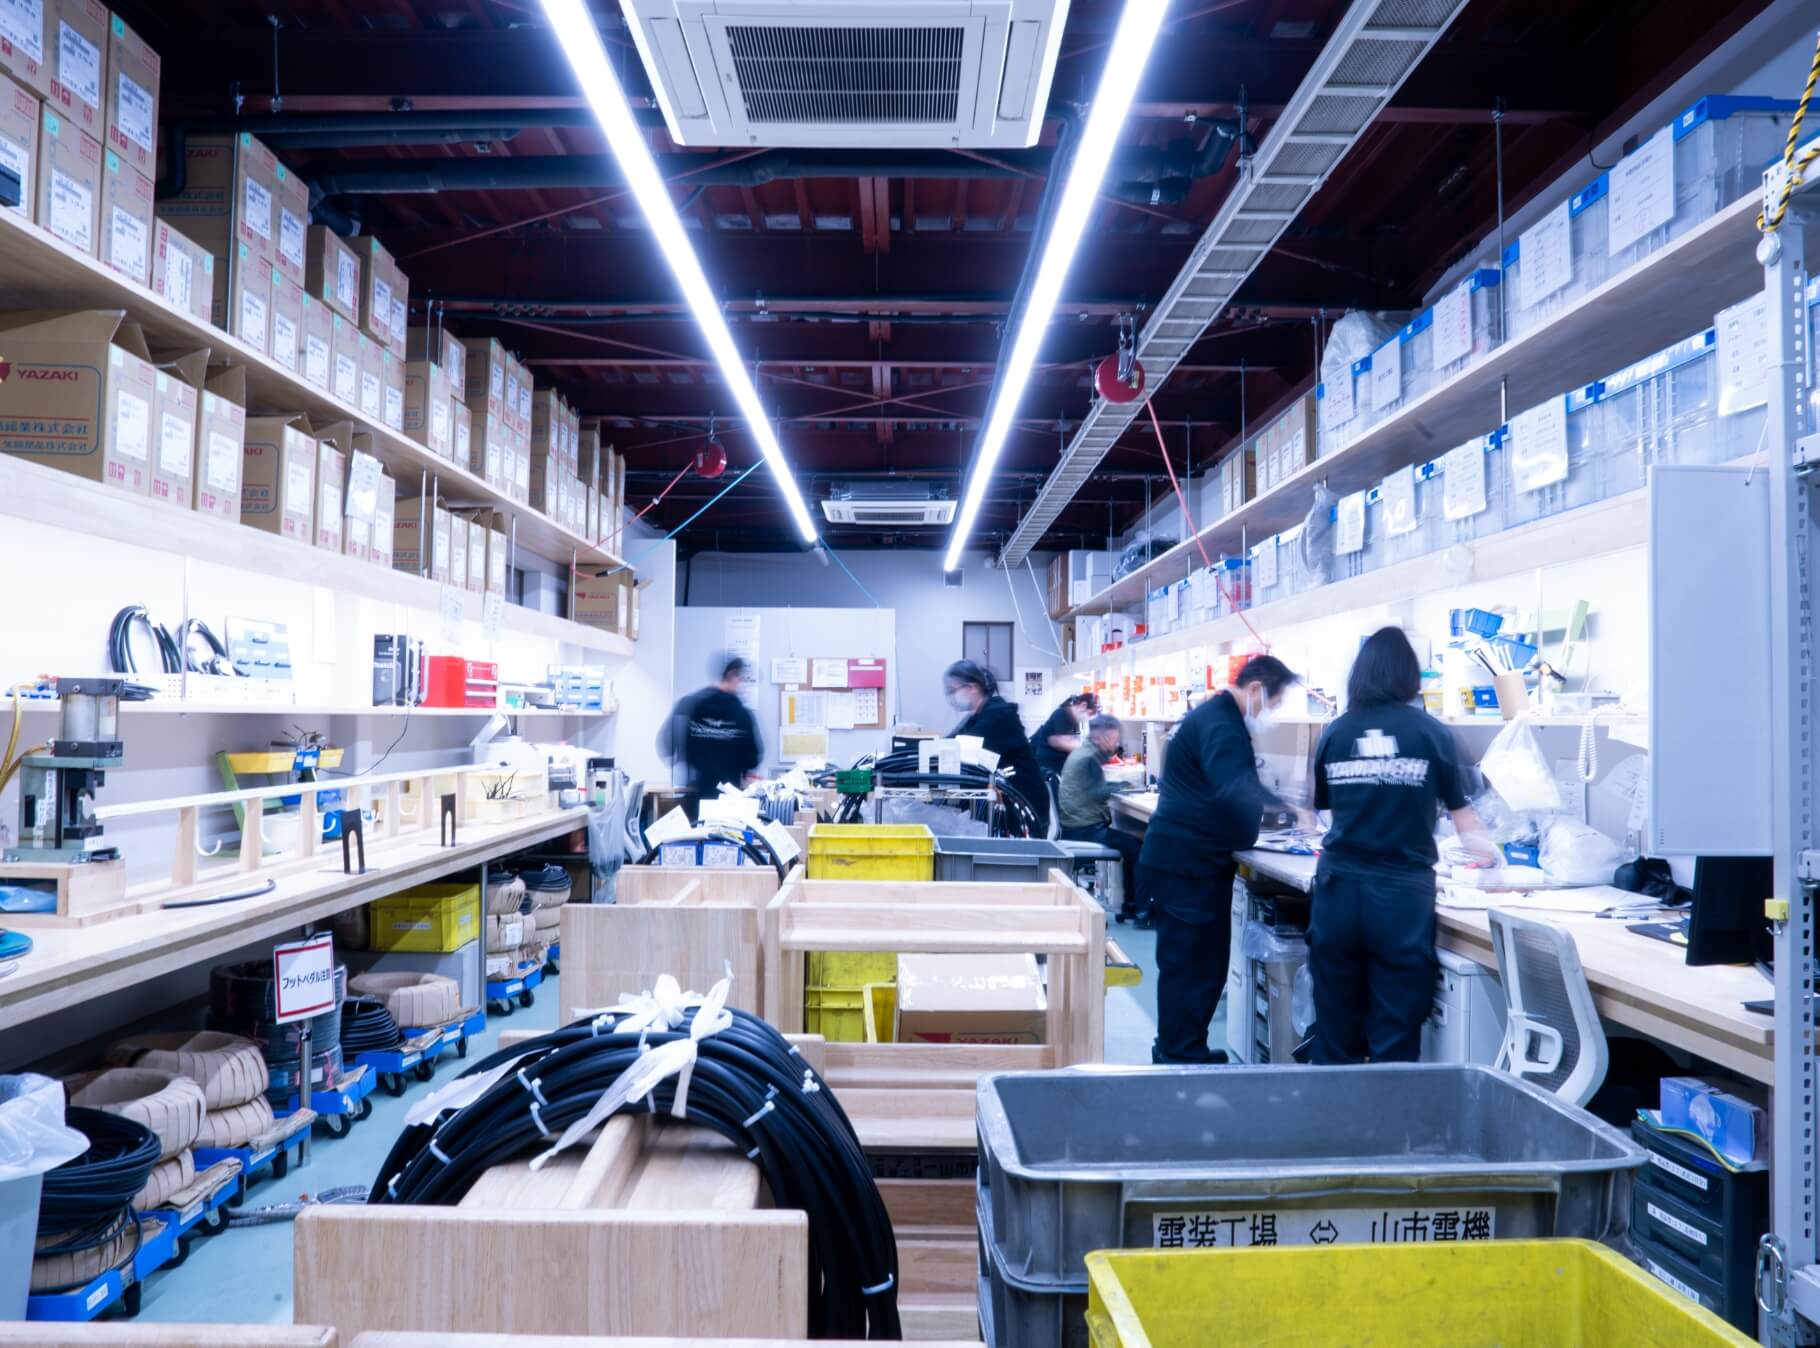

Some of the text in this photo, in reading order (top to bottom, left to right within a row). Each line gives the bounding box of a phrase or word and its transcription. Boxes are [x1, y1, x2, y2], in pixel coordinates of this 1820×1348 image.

[17, 368, 79, 382] YAZAKI
[1158, 1210, 1491, 1248] 電装工場 山市電機
